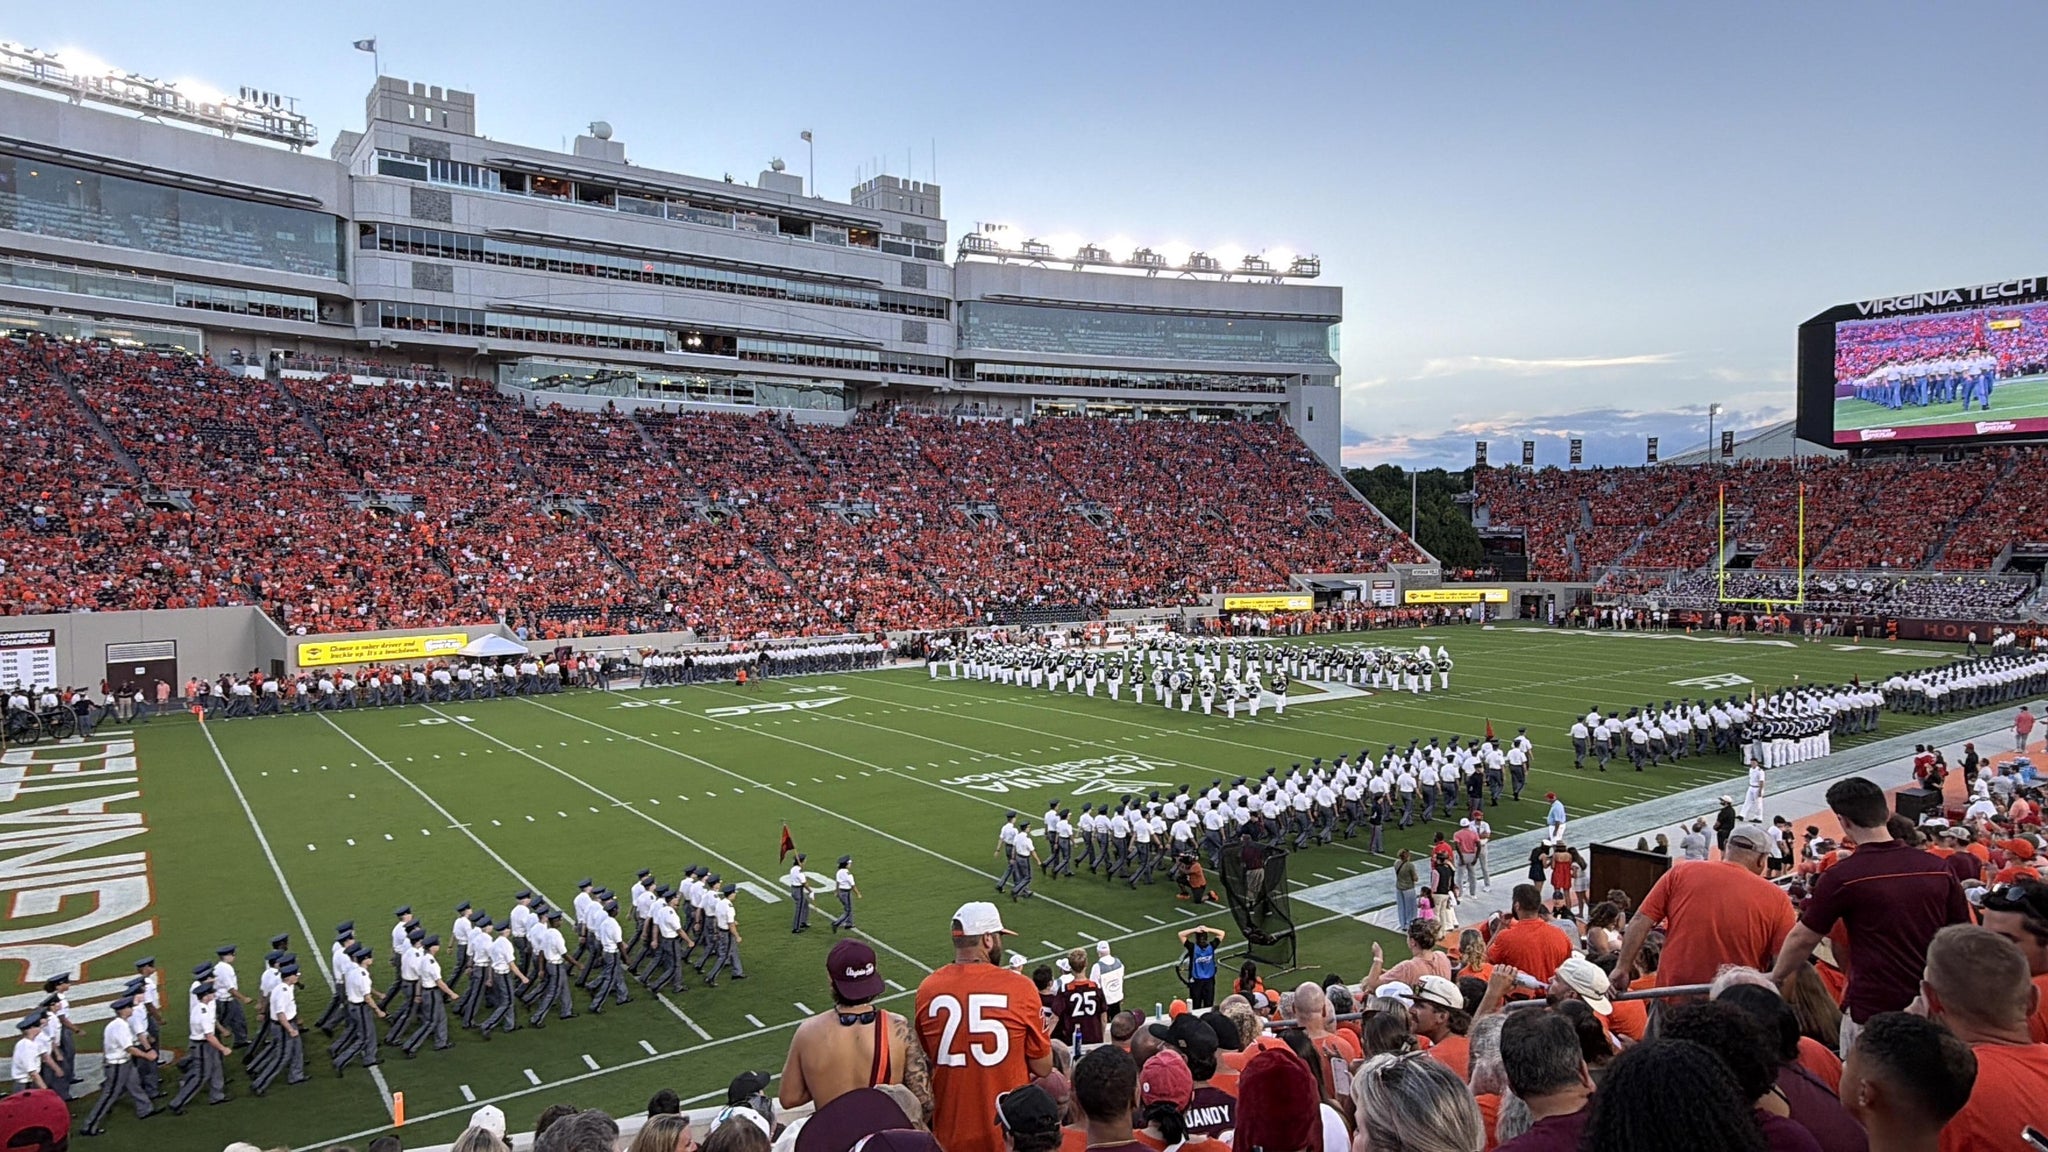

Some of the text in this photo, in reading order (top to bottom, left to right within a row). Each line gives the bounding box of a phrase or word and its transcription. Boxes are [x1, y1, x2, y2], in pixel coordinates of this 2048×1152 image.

[1855, 278, 2037, 316] VIRGINIA TECH
[1524, 450, 1532, 458] 10
[1571, 448, 1581, 457] 25
[1724, 441, 1730, 450] 7
[705, 696, 851, 717] ACC
[940, 754, 1139, 785] Credit Union
[965, 760, 1178, 793] VIRGINIA
[1070, 991, 1097, 1018] 25
[928, 994, 1010, 1067] 25
